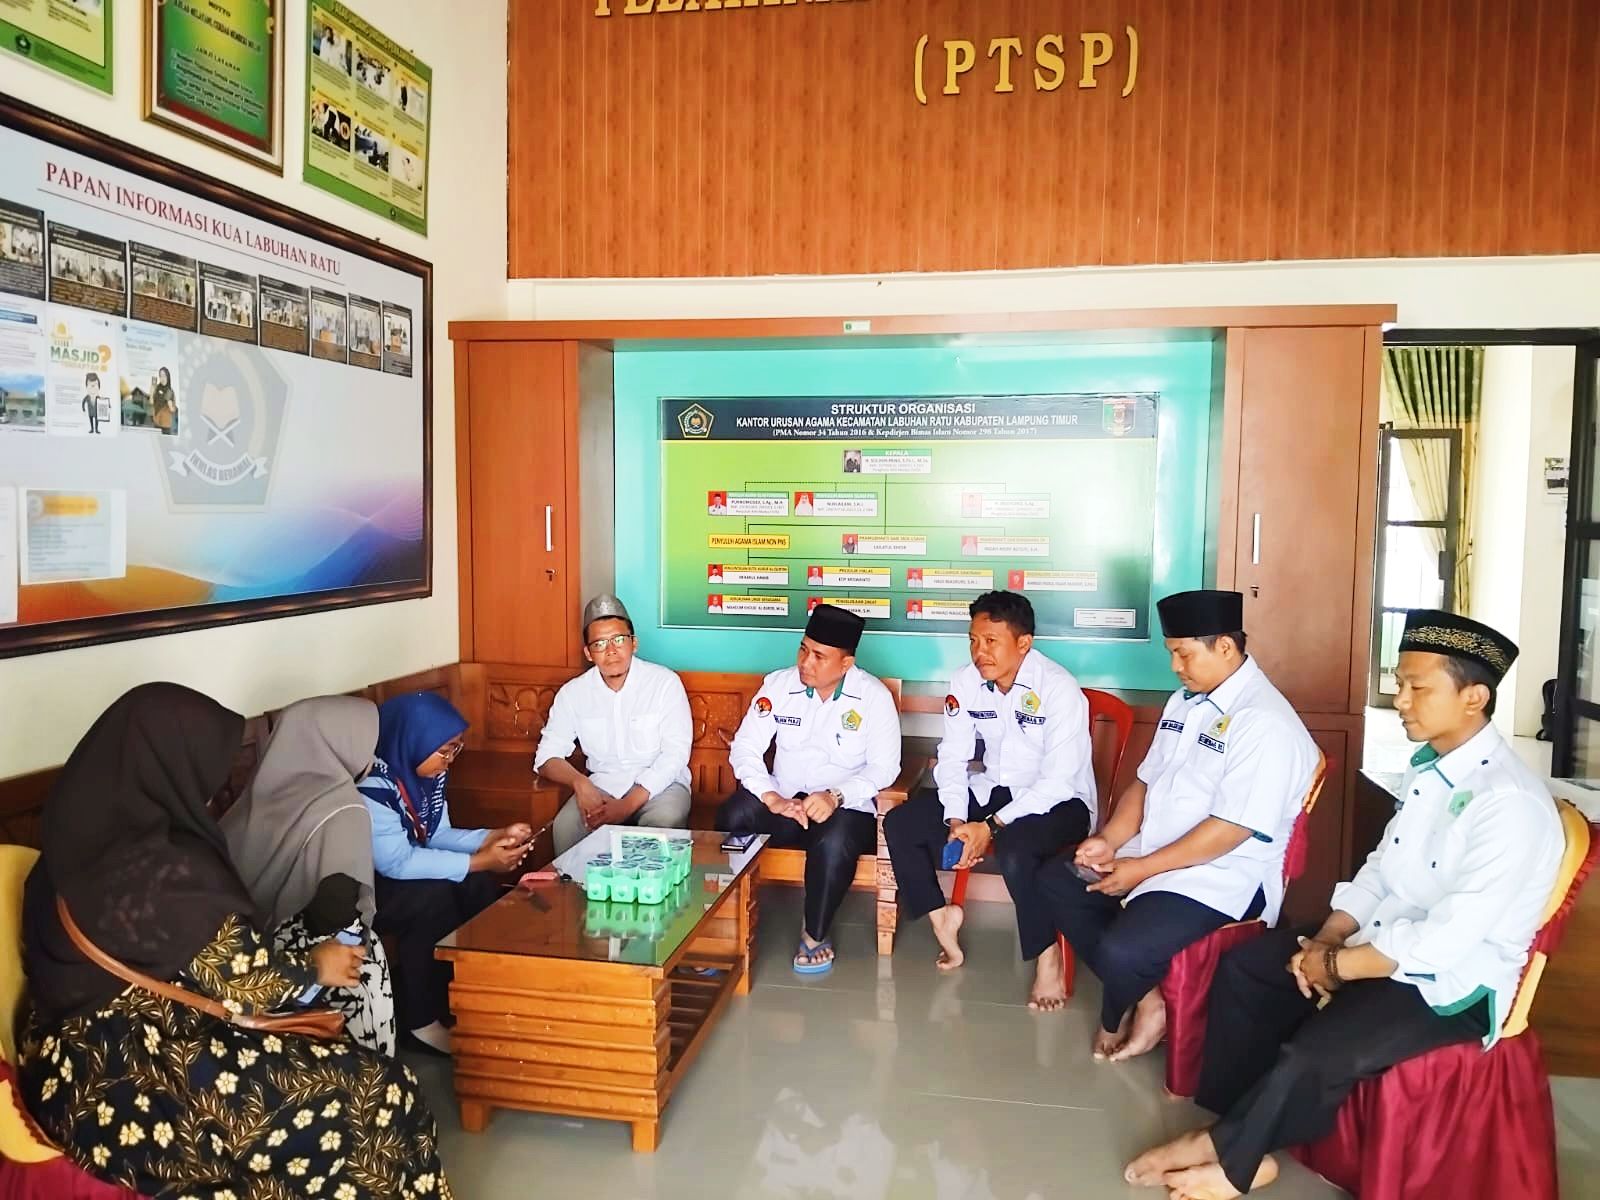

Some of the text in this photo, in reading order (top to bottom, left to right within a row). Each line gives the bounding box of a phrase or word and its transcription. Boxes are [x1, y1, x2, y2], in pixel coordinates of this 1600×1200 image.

[913, 25, 1139, 104] (PTSP)
[46, 162, 341, 276] PAPAN INFORMASI KUA LABUHAN RATU
[50, 345, 99, 364] MASJID
[831, 402, 976, 415] STRUKTUR ORGANISASI
[736, 414, 1079, 428] KANTOR URUSAN AGAMA KECAMATAN LABUHAN RATU KABUPATEN LAMPUNG TIMUR
[772, 428, 792, 437] (PMA
[828, 428, 849, 436] Tahun
